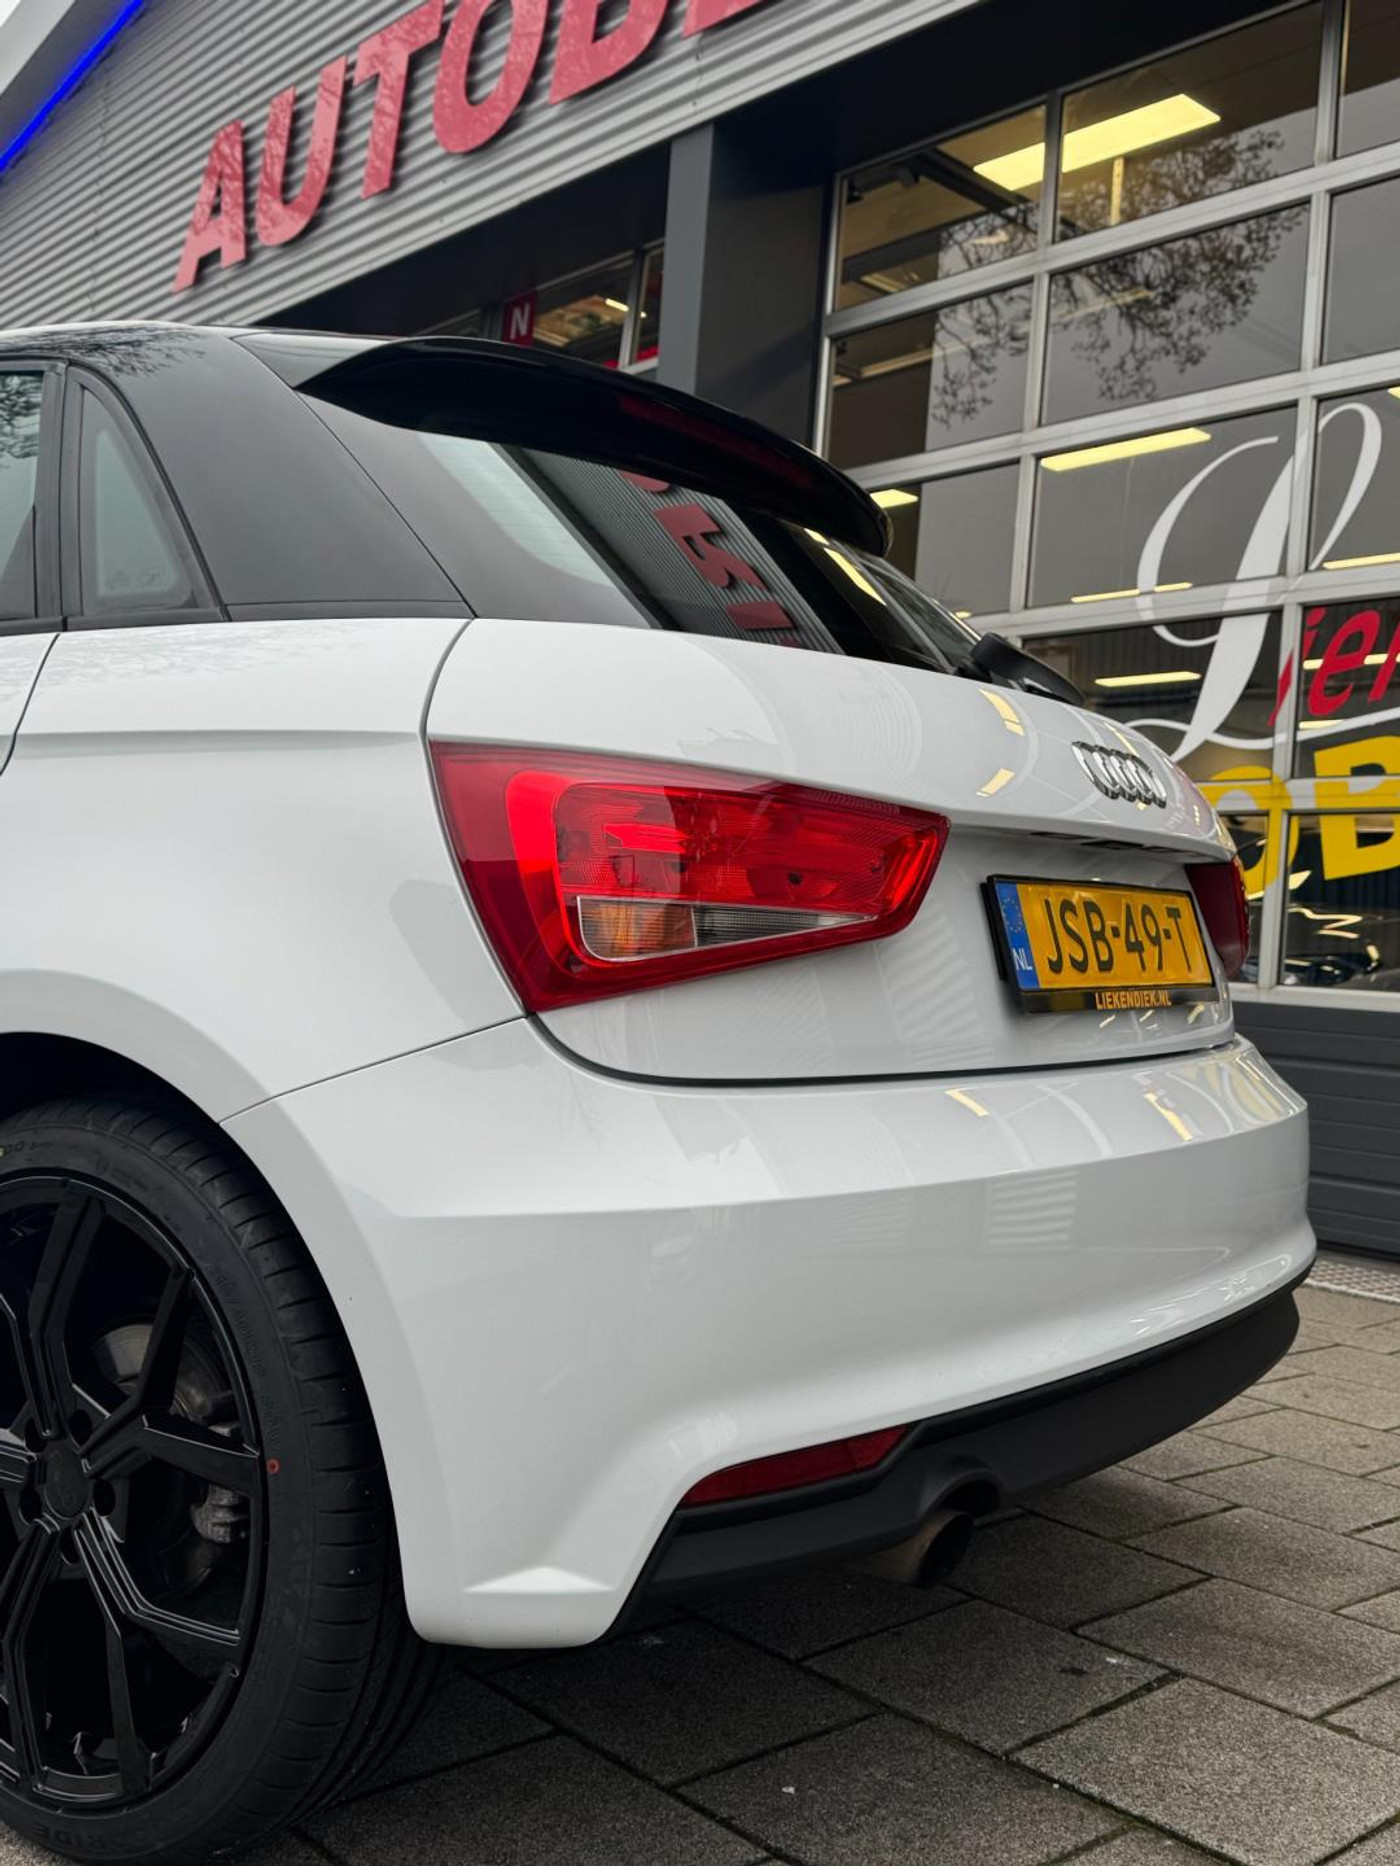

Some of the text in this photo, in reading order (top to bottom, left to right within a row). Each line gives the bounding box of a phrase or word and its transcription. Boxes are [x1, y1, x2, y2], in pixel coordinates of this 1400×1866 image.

[510, 303, 530, 341] N
[1044, 897, 1192, 974] JSB-49-T
[1012, 948, 1033, 971] NL
[1095, 990, 1172, 1010] LIEKENDIEK.NL
